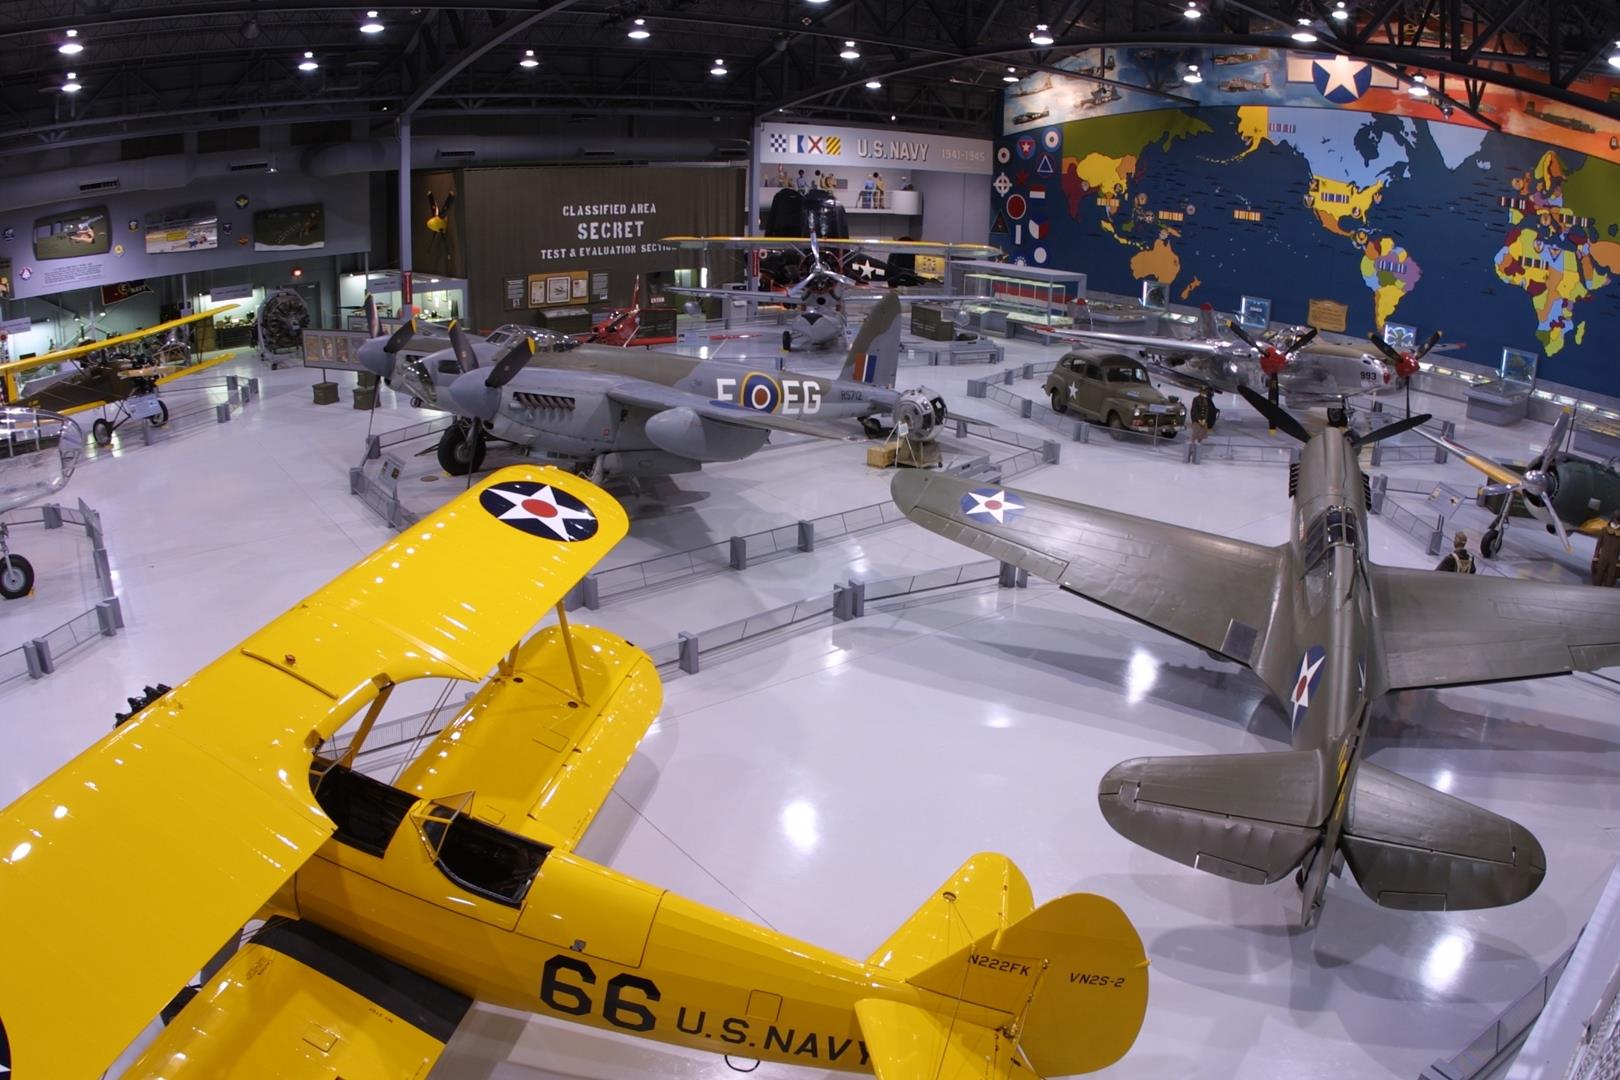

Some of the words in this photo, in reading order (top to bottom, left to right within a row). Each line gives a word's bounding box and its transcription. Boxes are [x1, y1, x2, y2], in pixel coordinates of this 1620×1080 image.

[942, 148, 985, 162] 1941-1945
[562, 204, 627, 217] CLASSIFIED
[630, 203, 657, 214] AREA
[577, 221, 644, 240] SECRET
[540, 248, 567, 259] TEST
[569, 248, 577, 258] &
[579, 244, 637, 257] EVALUATION
[1360, 371, 1377, 381] 993
[782, 379, 821, 415] EG
[840, 390, 863, 401] RS712
[968, 954, 1031, 977] N222FK
[1069, 972, 1125, 988] VN2S-2
[540, 954, 662, 1032] 66
